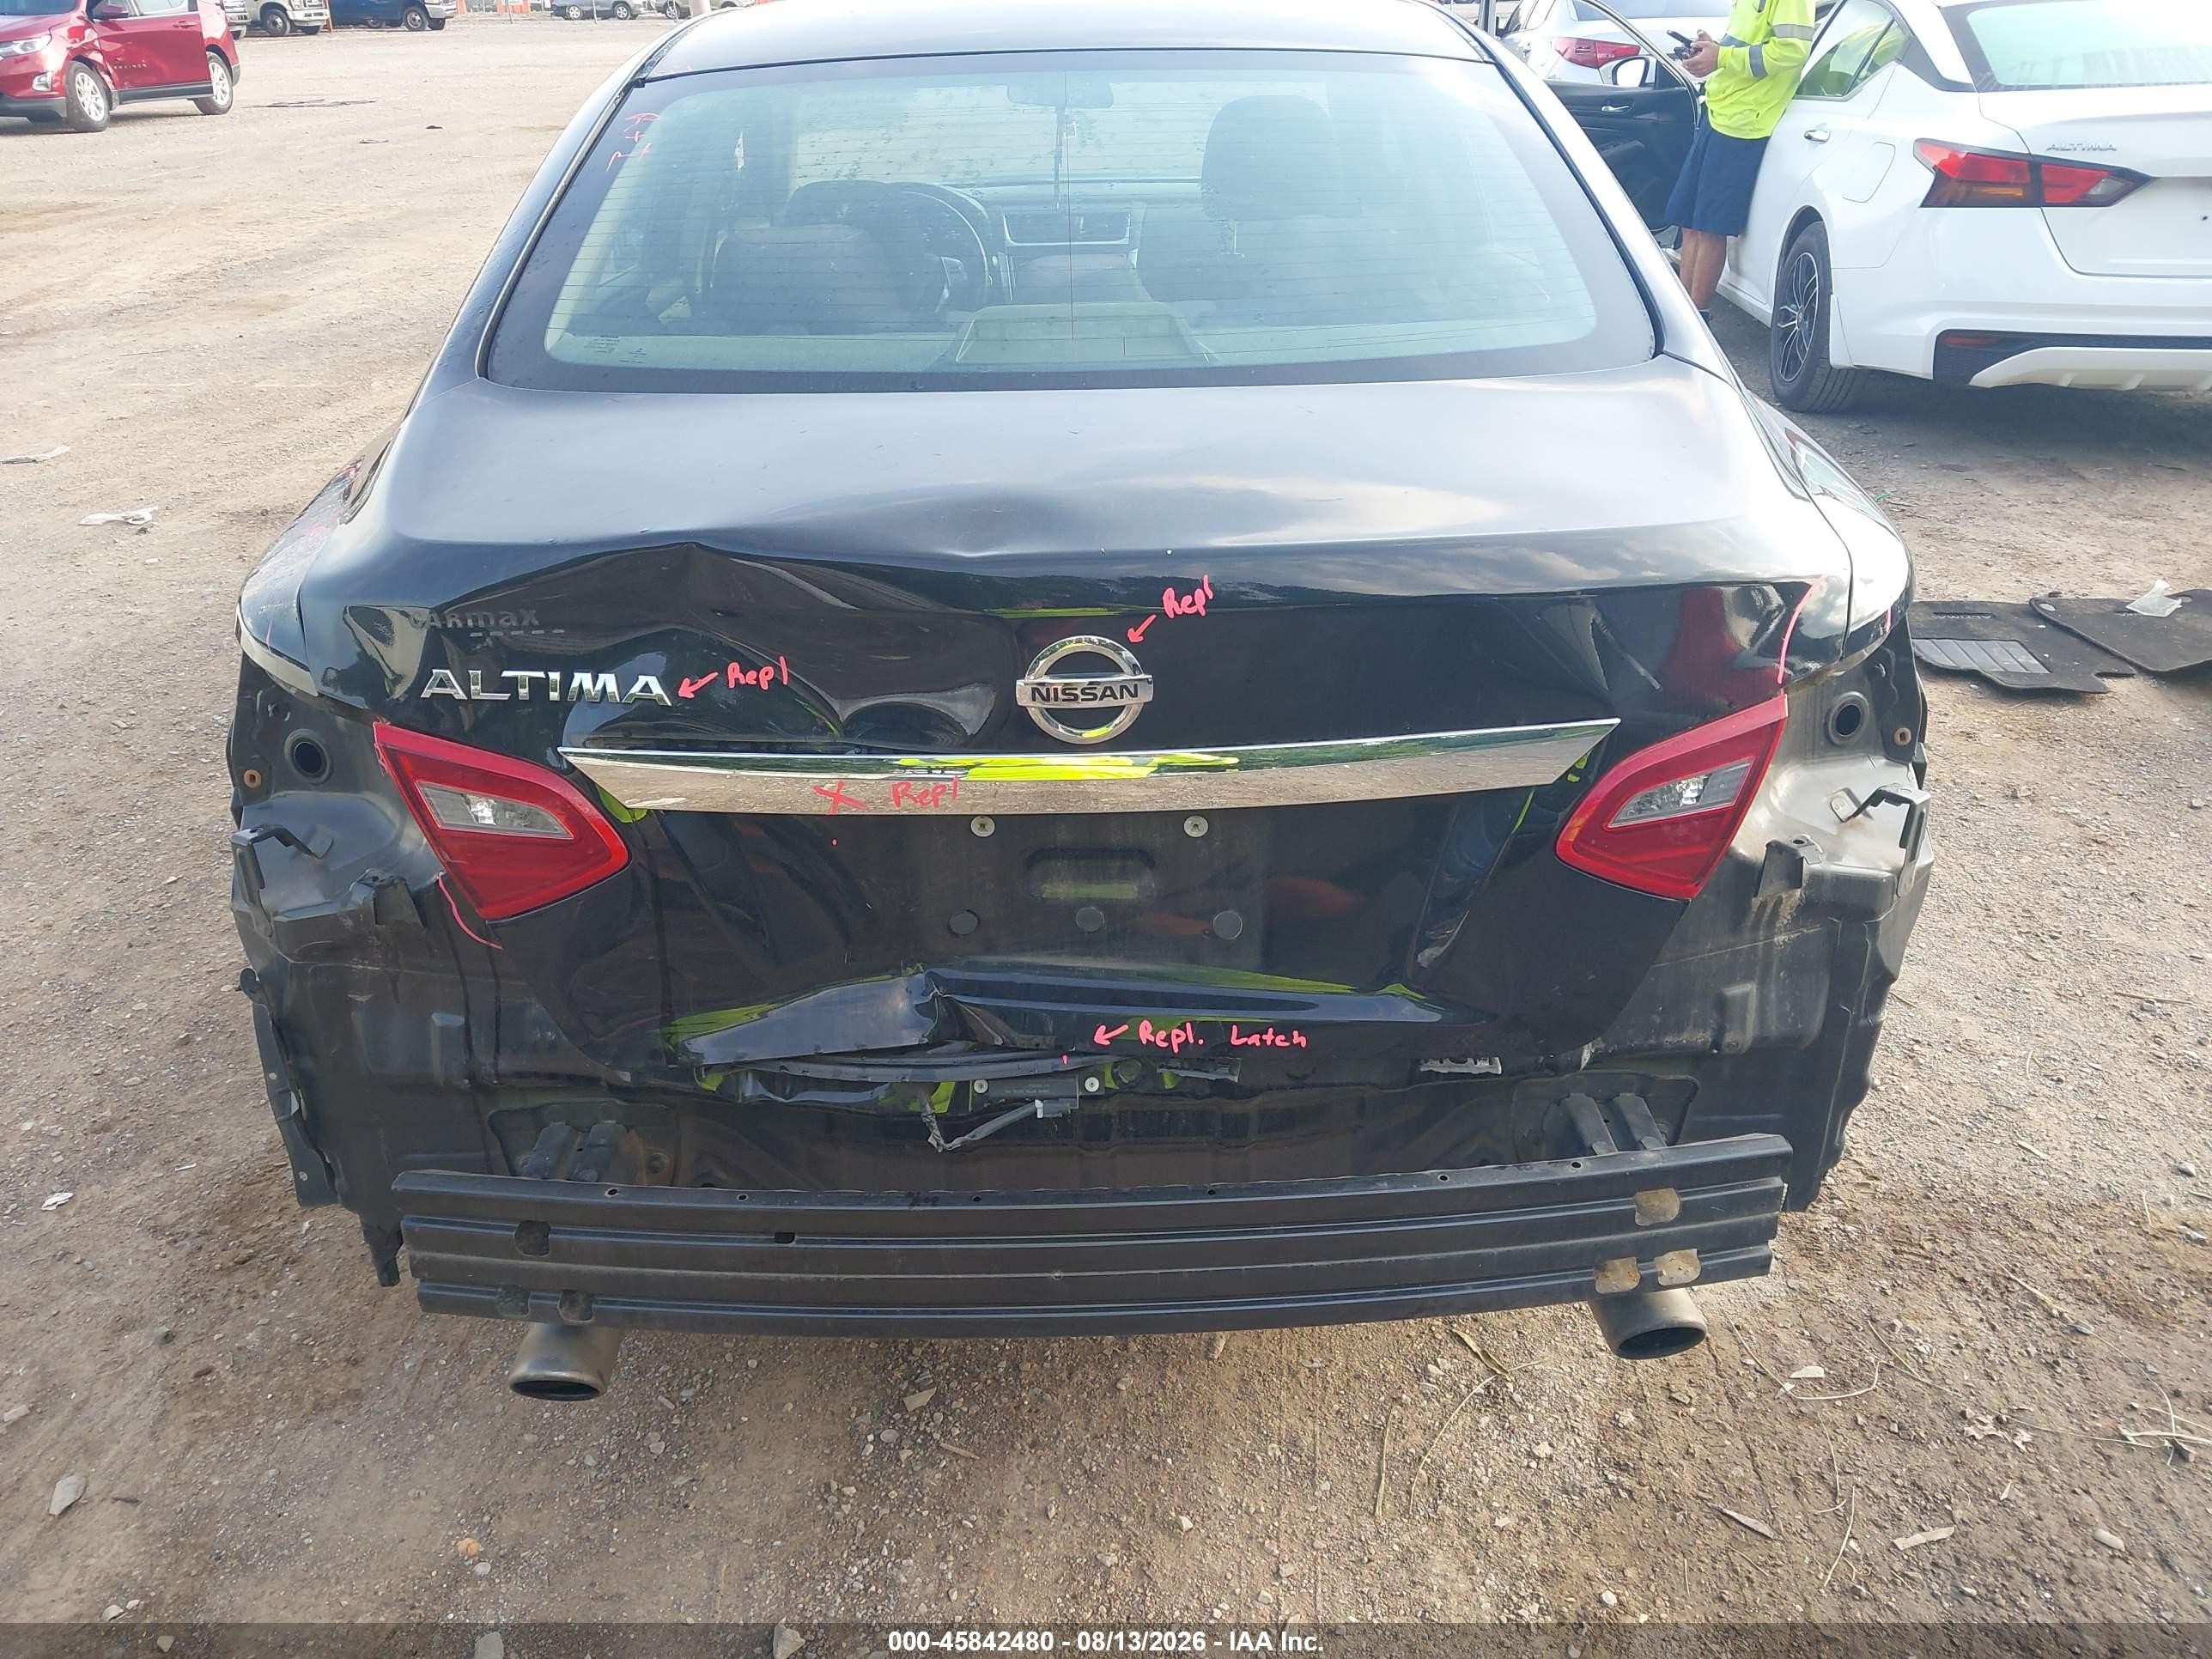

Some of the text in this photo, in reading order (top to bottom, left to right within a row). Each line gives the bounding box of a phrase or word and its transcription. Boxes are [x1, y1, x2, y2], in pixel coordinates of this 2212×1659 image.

[2046, 143, 2117, 152] ALTIMA
[1162, 574, 1213, 618] Repl
[421, 669, 672, 707] ALTIMA
[726, 655, 789, 690] Repl
[1031, 684, 1139, 702] NISSAN
[890, 775, 960, 809] Repl
[1138, 1018, 1308, 1054] Repl. Latch
